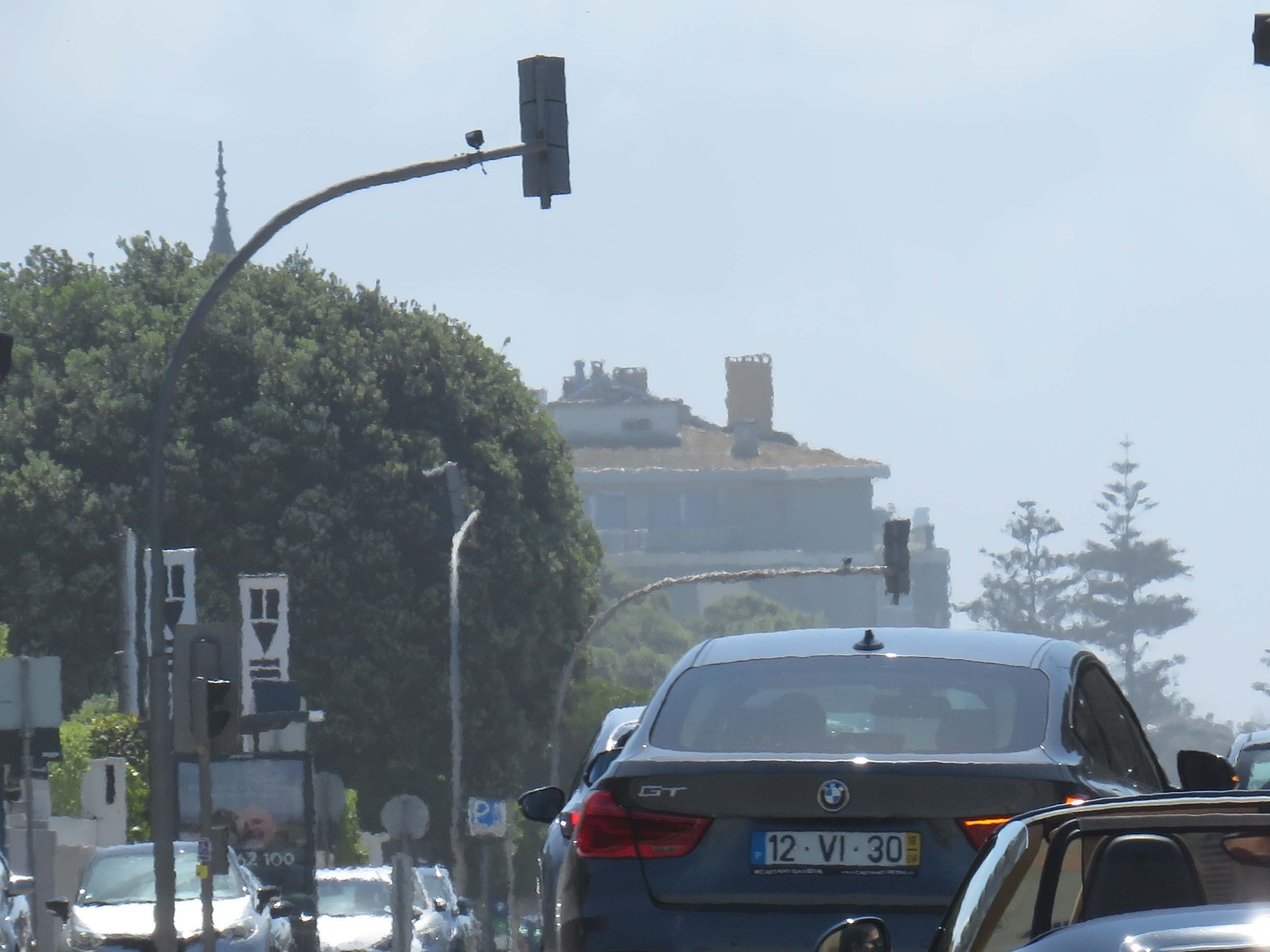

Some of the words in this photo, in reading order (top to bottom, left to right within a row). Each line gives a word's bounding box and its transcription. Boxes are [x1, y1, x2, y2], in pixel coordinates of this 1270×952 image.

[637, 785, 687, 797] GT
[473, 800, 490, 824] P
[263, 851, 295, 867] 100
